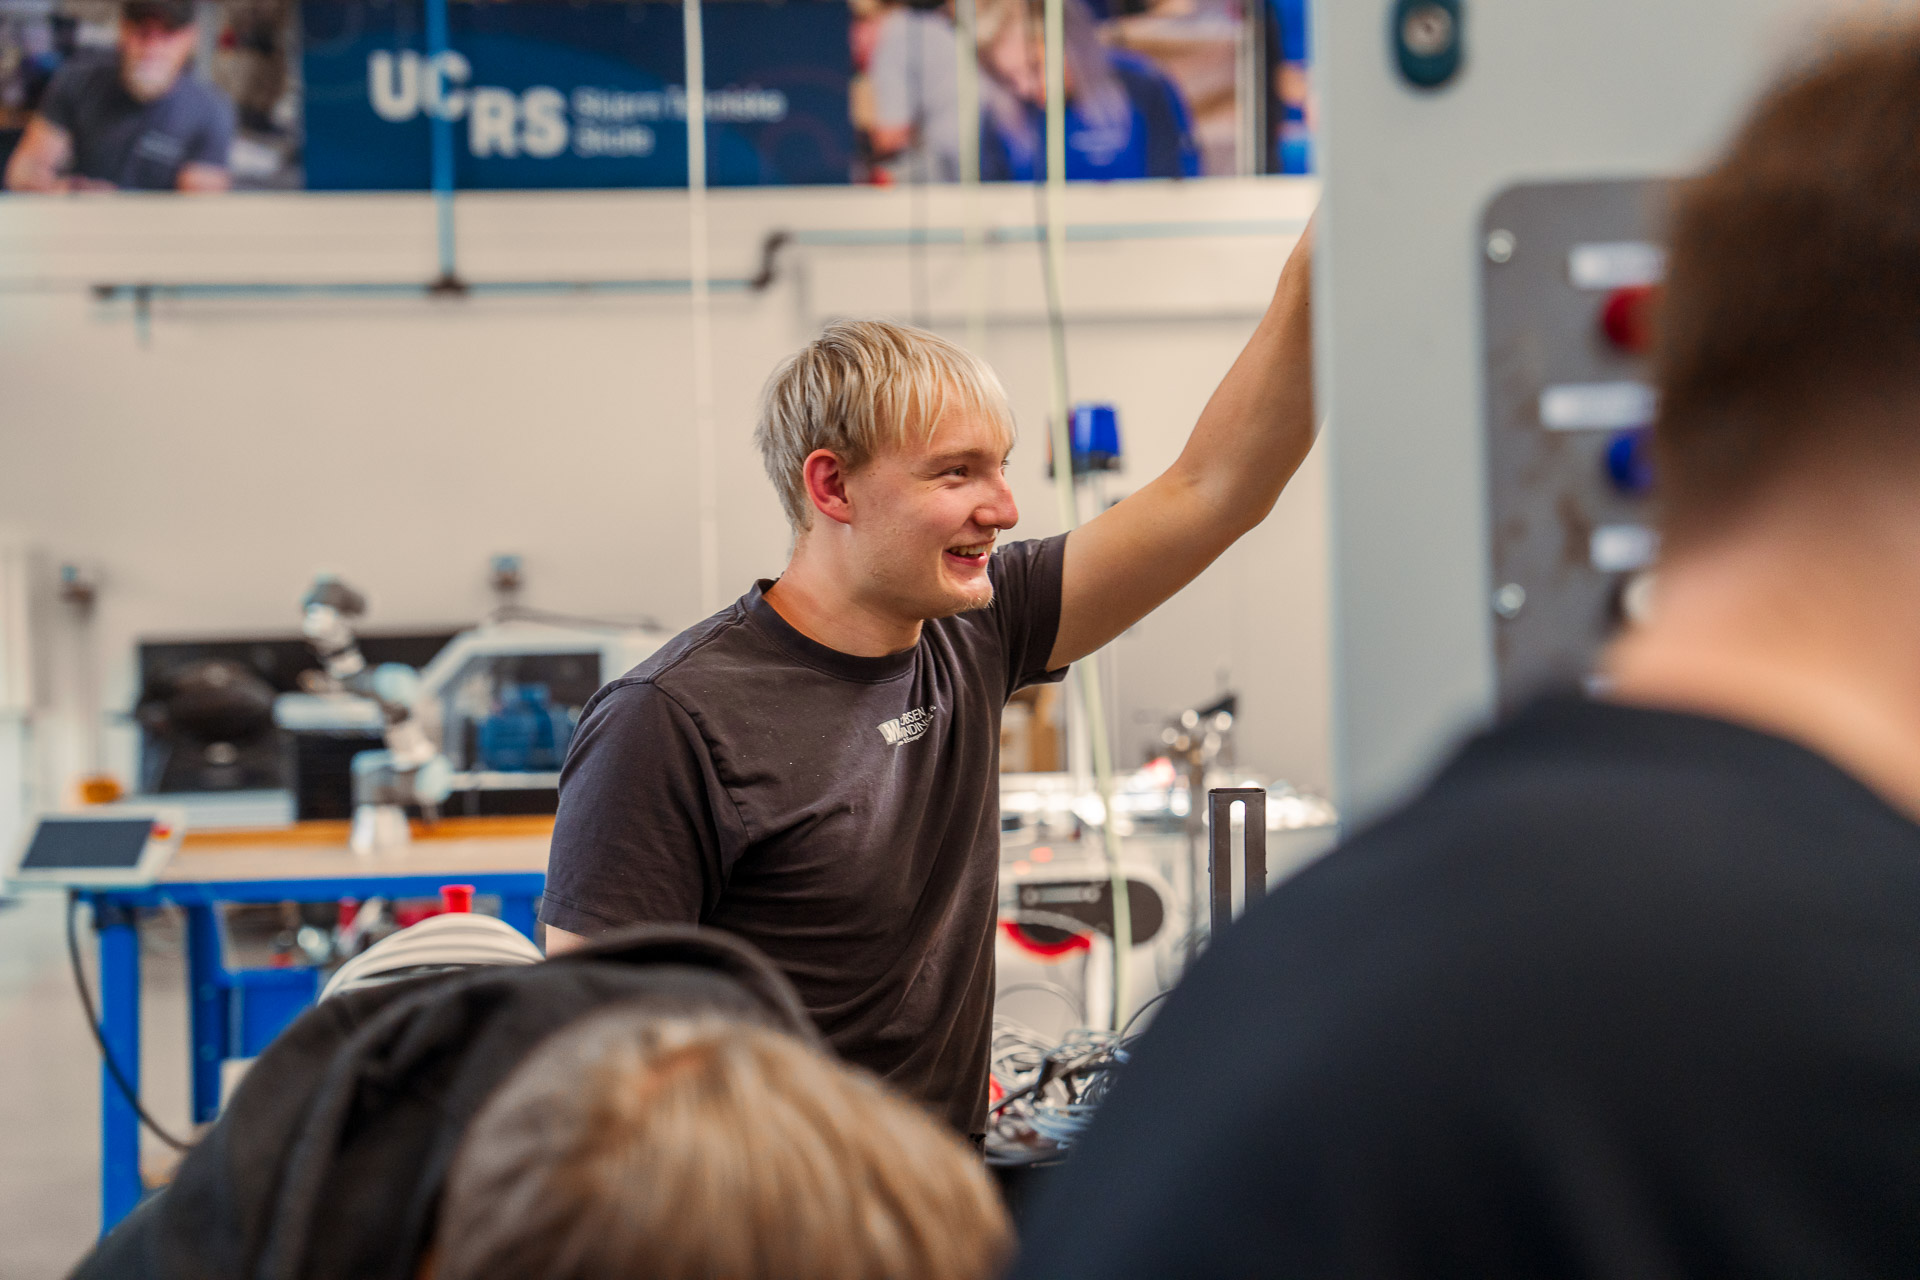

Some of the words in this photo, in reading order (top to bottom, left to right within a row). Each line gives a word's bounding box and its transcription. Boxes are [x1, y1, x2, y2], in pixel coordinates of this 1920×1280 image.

[369, 51, 470, 121] UC
[665, 85, 787, 121] Teniske
[469, 86, 568, 157] RS
